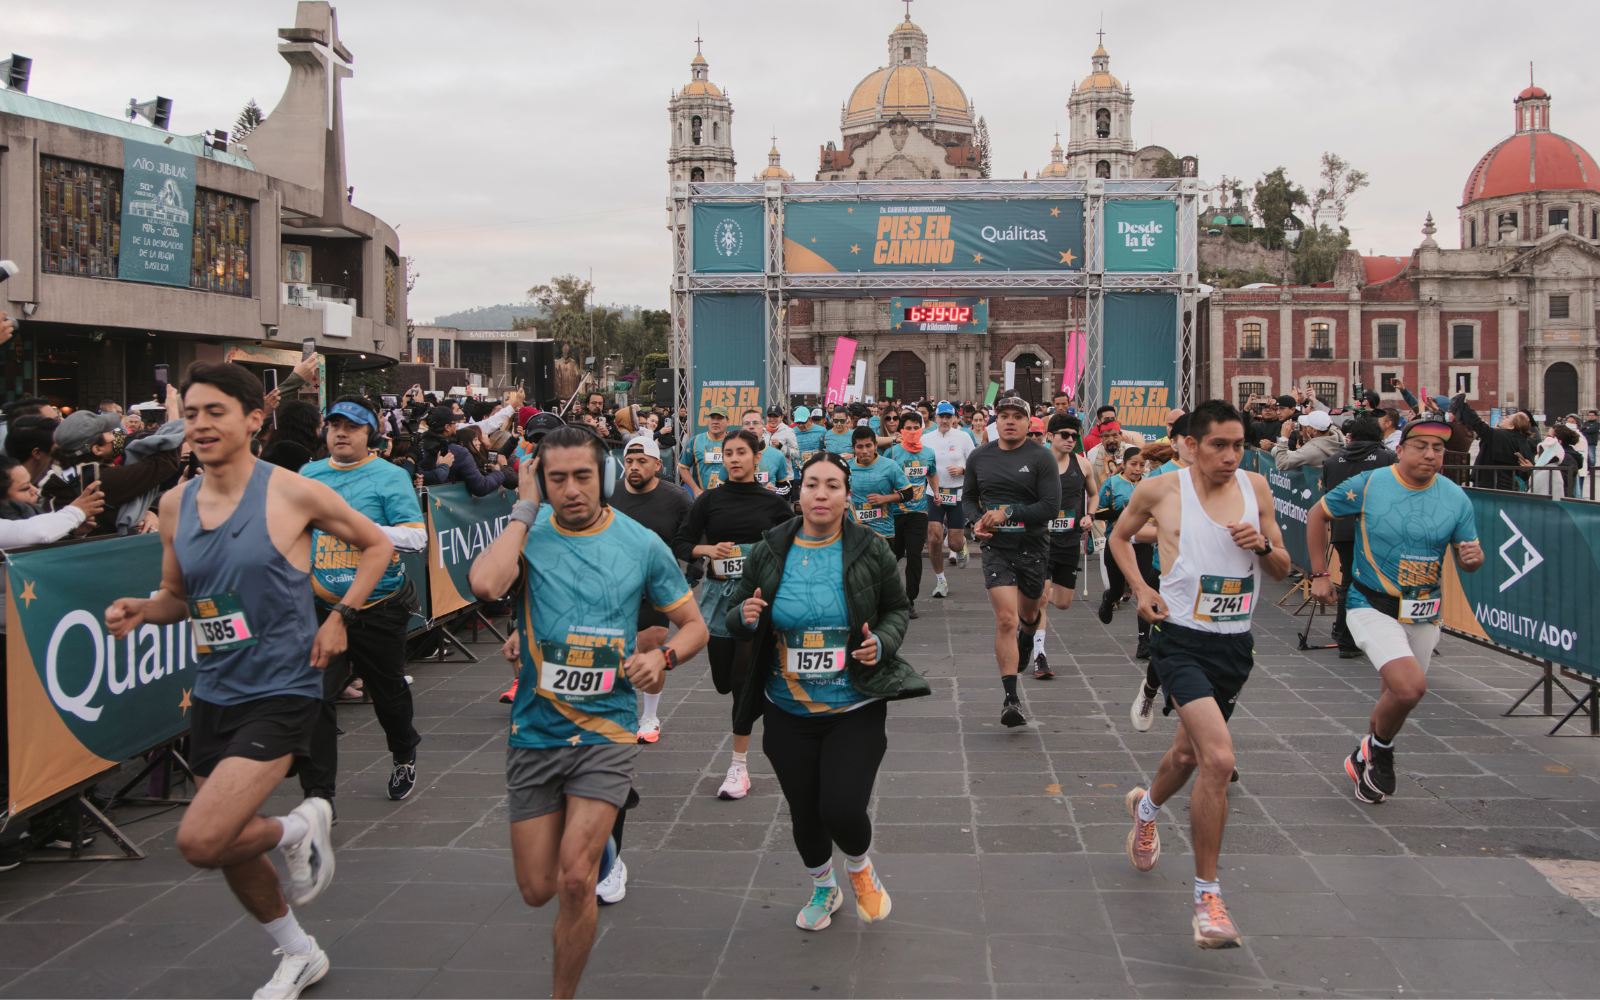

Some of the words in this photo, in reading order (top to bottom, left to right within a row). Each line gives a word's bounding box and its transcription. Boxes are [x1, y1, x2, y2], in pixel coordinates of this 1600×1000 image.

[133, 158, 154, 172] AÑO
[157, 162, 188, 179] JUBILAR
[908, 205, 946, 214] ARQUIDIOCESANA
[142, 223, 155, 233] 1976
[162, 226, 180, 238] 2026
[876, 215, 922, 240] PIES
[924, 215, 952, 240] EN
[1117, 220, 1163, 234] Desde
[132, 235, 141, 244] DE
[144, 237, 151, 246] LA
[1125, 233, 1139, 247] la
[1141, 233, 1155, 247] fe
[139, 248, 148, 258] DE
[149, 250, 157, 259] LA
[158, 250, 174, 261] NUEVA
[873, 239, 955, 265] CAMINO
[700, 387, 737, 407] PIES
[738, 387, 760, 407] EN
[1108, 386, 1146, 407] PIES
[1146, 387, 1169, 407] EN
[1269, 467, 1291, 490] Fundación
[859, 510, 878, 520] 2688
[1271, 489, 1308, 524] ompartamos
[1051, 519, 1069, 529] 1516
[1210, 595, 1244, 613] 2141
[200, 618, 236, 643] 1385
[1475, 602, 1538, 640] MOBILITY
[797, 651, 834, 670] 1575
[552, 668, 604, 692] 2091
